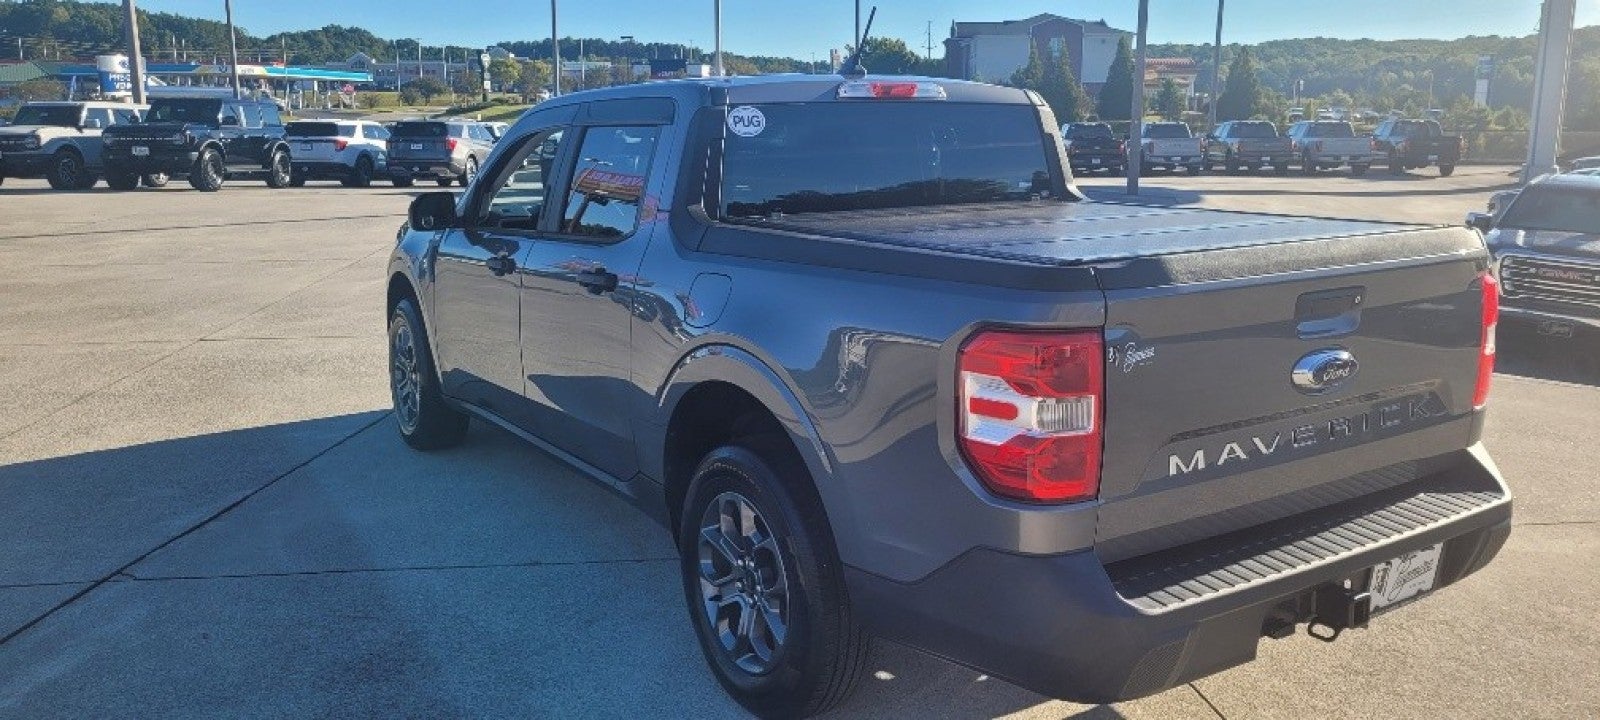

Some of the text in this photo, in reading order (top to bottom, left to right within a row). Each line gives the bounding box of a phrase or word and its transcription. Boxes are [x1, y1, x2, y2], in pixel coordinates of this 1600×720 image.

[733, 115, 760, 128] PUG
[1322, 362, 1351, 382] Ford
[1168, 399, 1431, 477] MAVERICK
